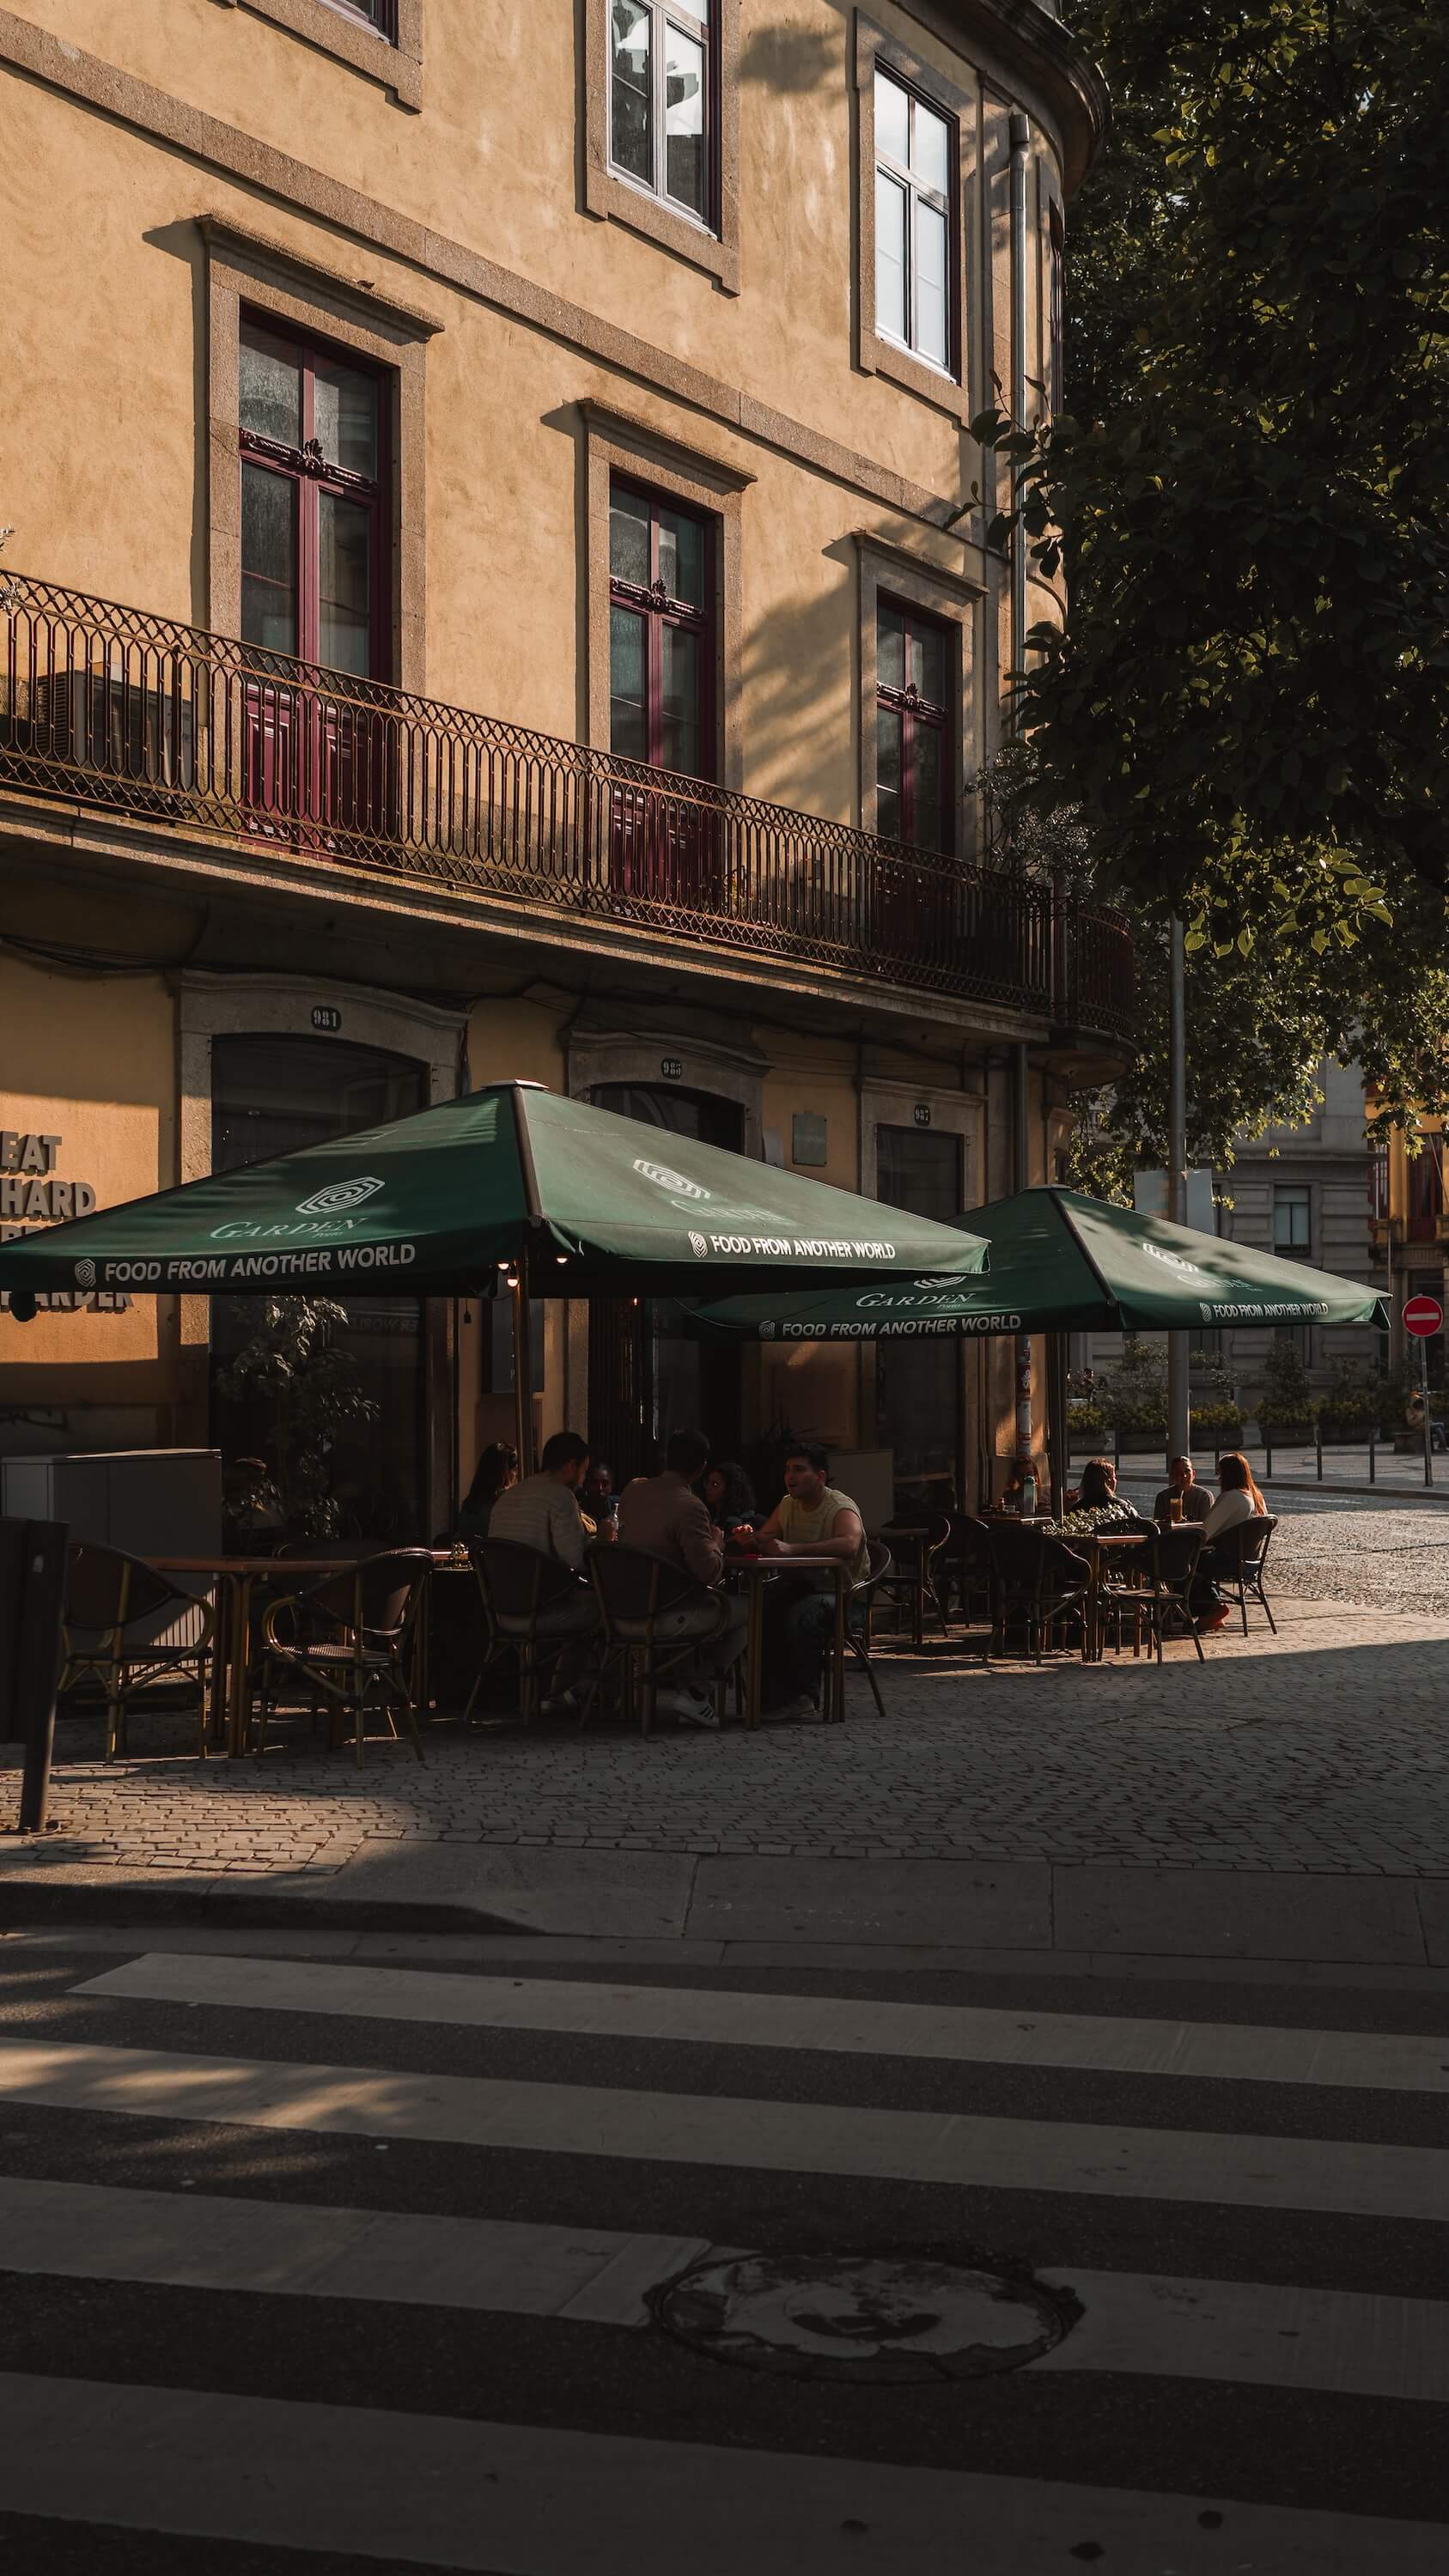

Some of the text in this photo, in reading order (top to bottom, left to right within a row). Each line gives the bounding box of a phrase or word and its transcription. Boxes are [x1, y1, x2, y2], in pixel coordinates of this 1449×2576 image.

[313, 1009, 338, 1028] 981
[915, 1109, 929, 1121] 987
[0, 1131, 62, 1171] EAT
[0, 1179, 97, 1218] HARD
[210, 1217, 369, 1239] GARDEN
[709, 1235, 896, 1260] FOOD FROM ANOTHER WORLD
[105, 1243, 416, 1282] FOOD FROM ANOTHER WORLD
[855, 1292, 976, 1307] GARDEN
[1212, 1303, 1329, 1318] FOOD FROM ANOTHER WORLD
[782, 1315, 1021, 1337] FOOD FROM ANOTHER WORLD
